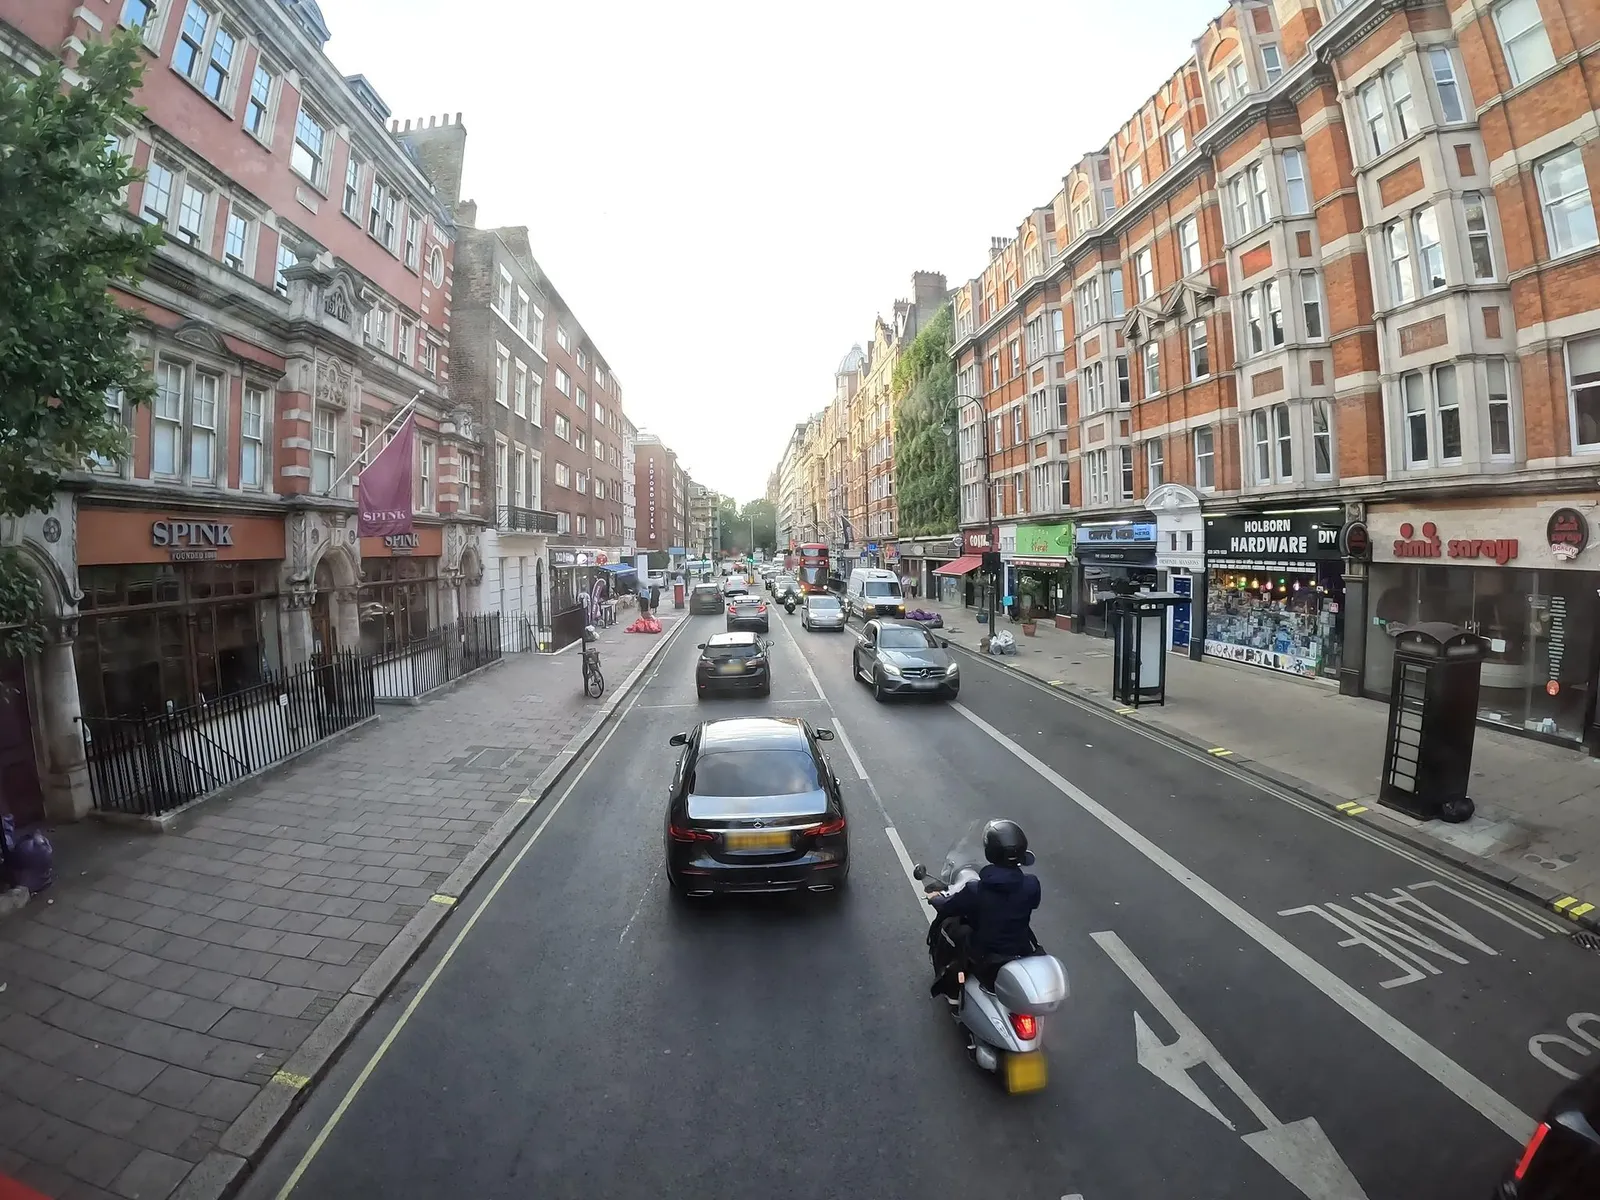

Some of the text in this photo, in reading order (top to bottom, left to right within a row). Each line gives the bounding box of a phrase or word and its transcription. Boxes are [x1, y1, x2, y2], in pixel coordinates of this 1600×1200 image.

[363, 510, 406, 522] SPINK
[153, 521, 234, 546] SPINK
[1244, 518, 1291, 533] HOLBORN
[385, 531, 421, 548] SPINK
[1230, 535, 1308, 554] HARDWARE
[1318, 530, 1338, 544] DIY
[1393, 521, 1442, 558] simit
[1277, 880, 1546, 989] LANE
